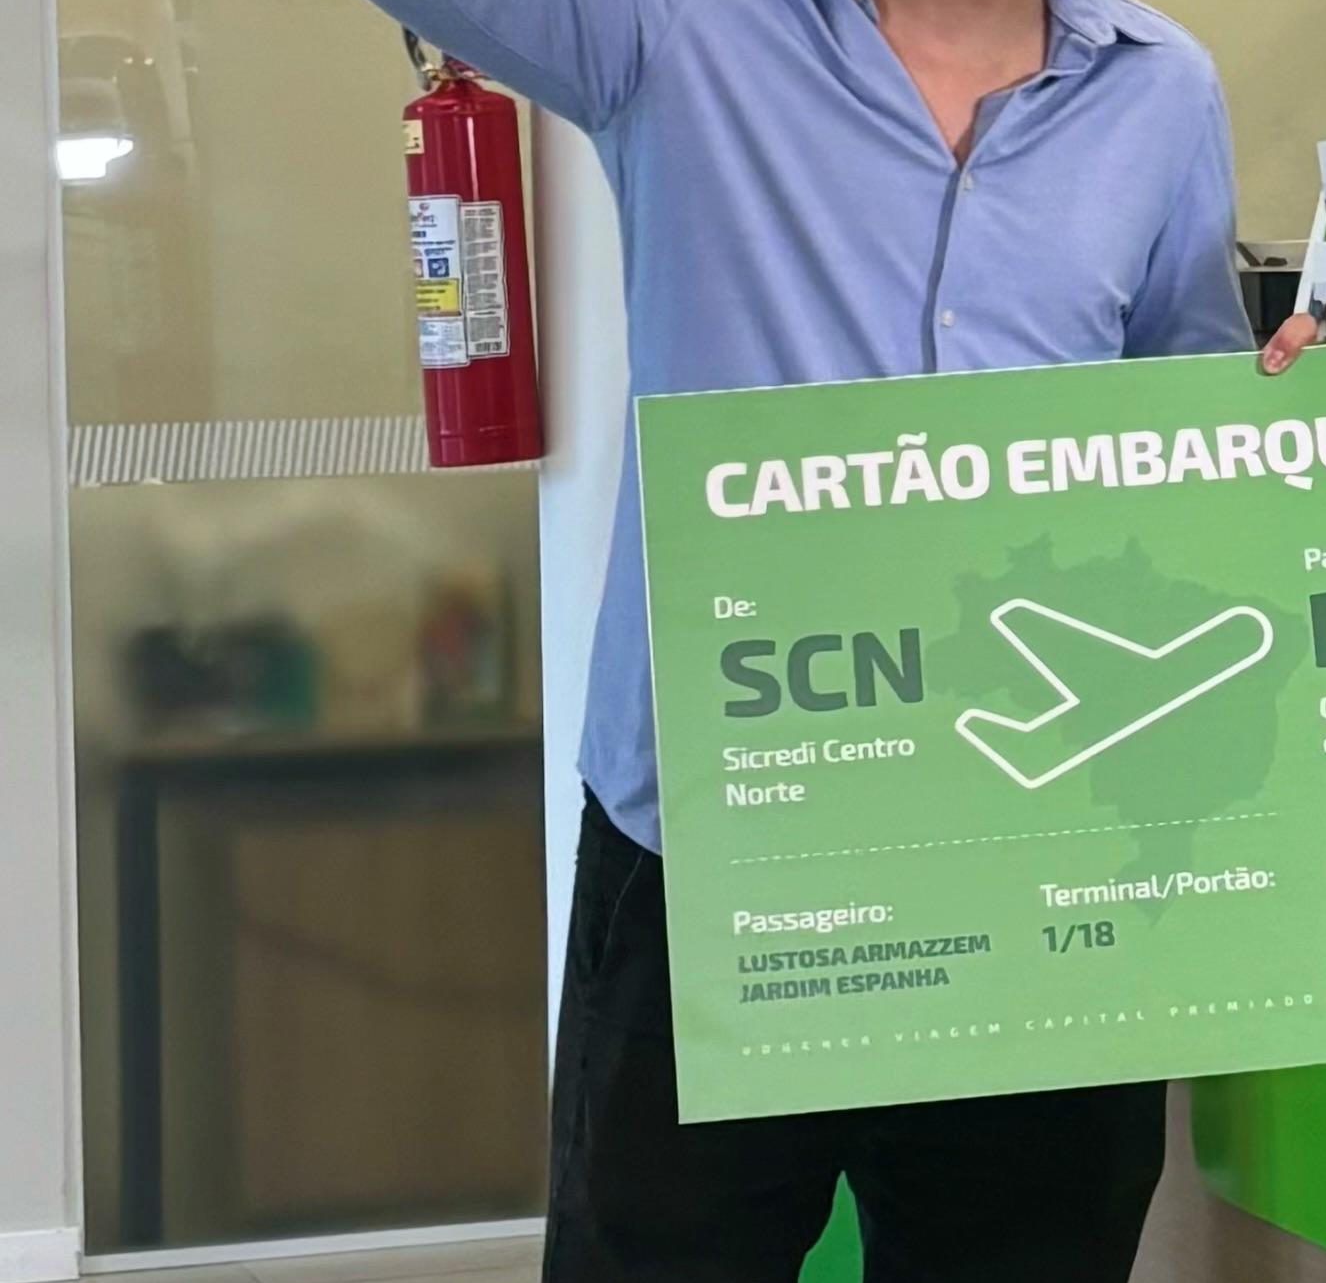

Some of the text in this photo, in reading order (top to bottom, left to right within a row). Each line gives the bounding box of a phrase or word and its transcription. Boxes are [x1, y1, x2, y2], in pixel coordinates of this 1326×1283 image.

[705, 432, 990, 518] CARTÃO
[714, 596, 757, 619] De:
[719, 628, 924, 718] SCN
[723, 737, 916, 771] Sicredi Centro
[726, 781, 806, 806] Norte
[1039, 866, 1276, 908] Terminal/Portão:
[732, 903, 895, 936] Passageiro:
[1042, 920, 1116, 954] 1/18
[737, 934, 992, 974] LUSTOSA ARMAZZEM
[739, 967, 951, 1004] JARDIM ESPANHA
[894, 1022, 1001, 1044] VIAGEM
[1025, 1010, 1146, 1031] CAPITAL
[1169, 993, 1313, 1018] PREMIADO
